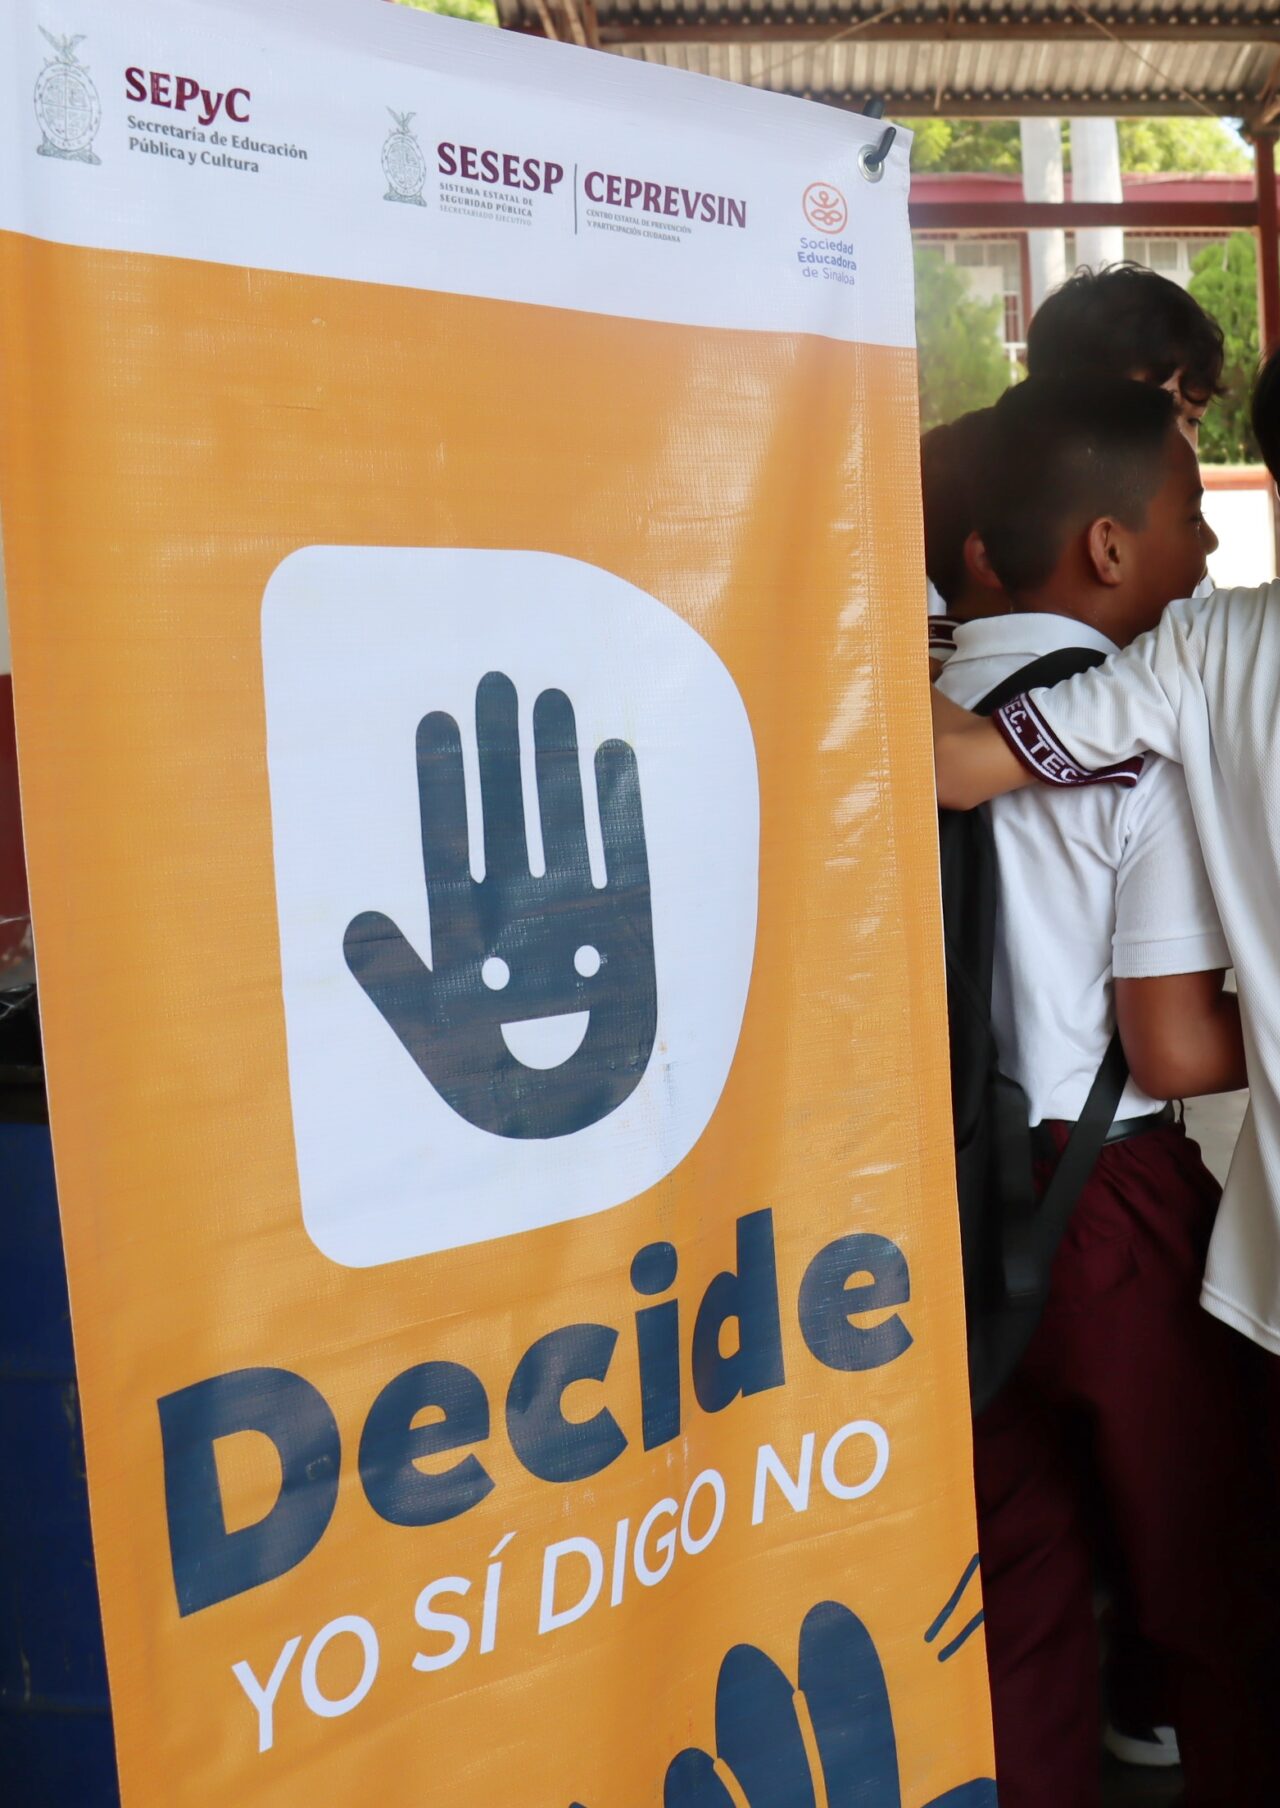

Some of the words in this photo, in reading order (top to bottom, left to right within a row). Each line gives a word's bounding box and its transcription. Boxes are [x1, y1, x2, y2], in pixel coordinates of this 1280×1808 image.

[125, 67, 251, 126] SEPyC
[127, 115, 206, 143] Secretaría
[210, 131, 228, 146] de
[232, 135, 308, 160] Educación
[129, 136, 185, 160] Pública
[188, 151, 197, 166] y
[200, 150, 259, 173] Cultura
[437, 142, 564, 195] SESESP
[439, 182, 481, 197] SISTEMA
[483, 189, 520, 204] ESTATAL
[522, 197, 534, 207] DE
[439, 193, 494, 210] SEGURIDAD
[496, 202, 533, 217] PÚBLICA
[584, 171, 747, 229] CEPREVSIN
[586, 209, 613, 220] CENTRO
[614, 214, 640, 225] ESTATAL
[641, 218, 650, 227] DE
[651, 221, 692, 234] PREVENCIÓN
[593, 220, 642, 237] PARTICIPACIÓN
[642, 229, 681, 243] CIUDADANA
[797, 251, 857, 271] Educadora
[799, 236, 854, 255] Sociedad
[802, 266, 819, 278] de
[822, 267, 855, 286] Sinaloa
[1004, 696, 1027, 734] EC.
[156, 1207, 914, 1619] Decide
[232, 1613, 381, 1753] YO
[411, 1532, 518, 1672] SÍ
[537, 1469, 727, 1636] DIGO
[751, 1419, 891, 1527] NO
